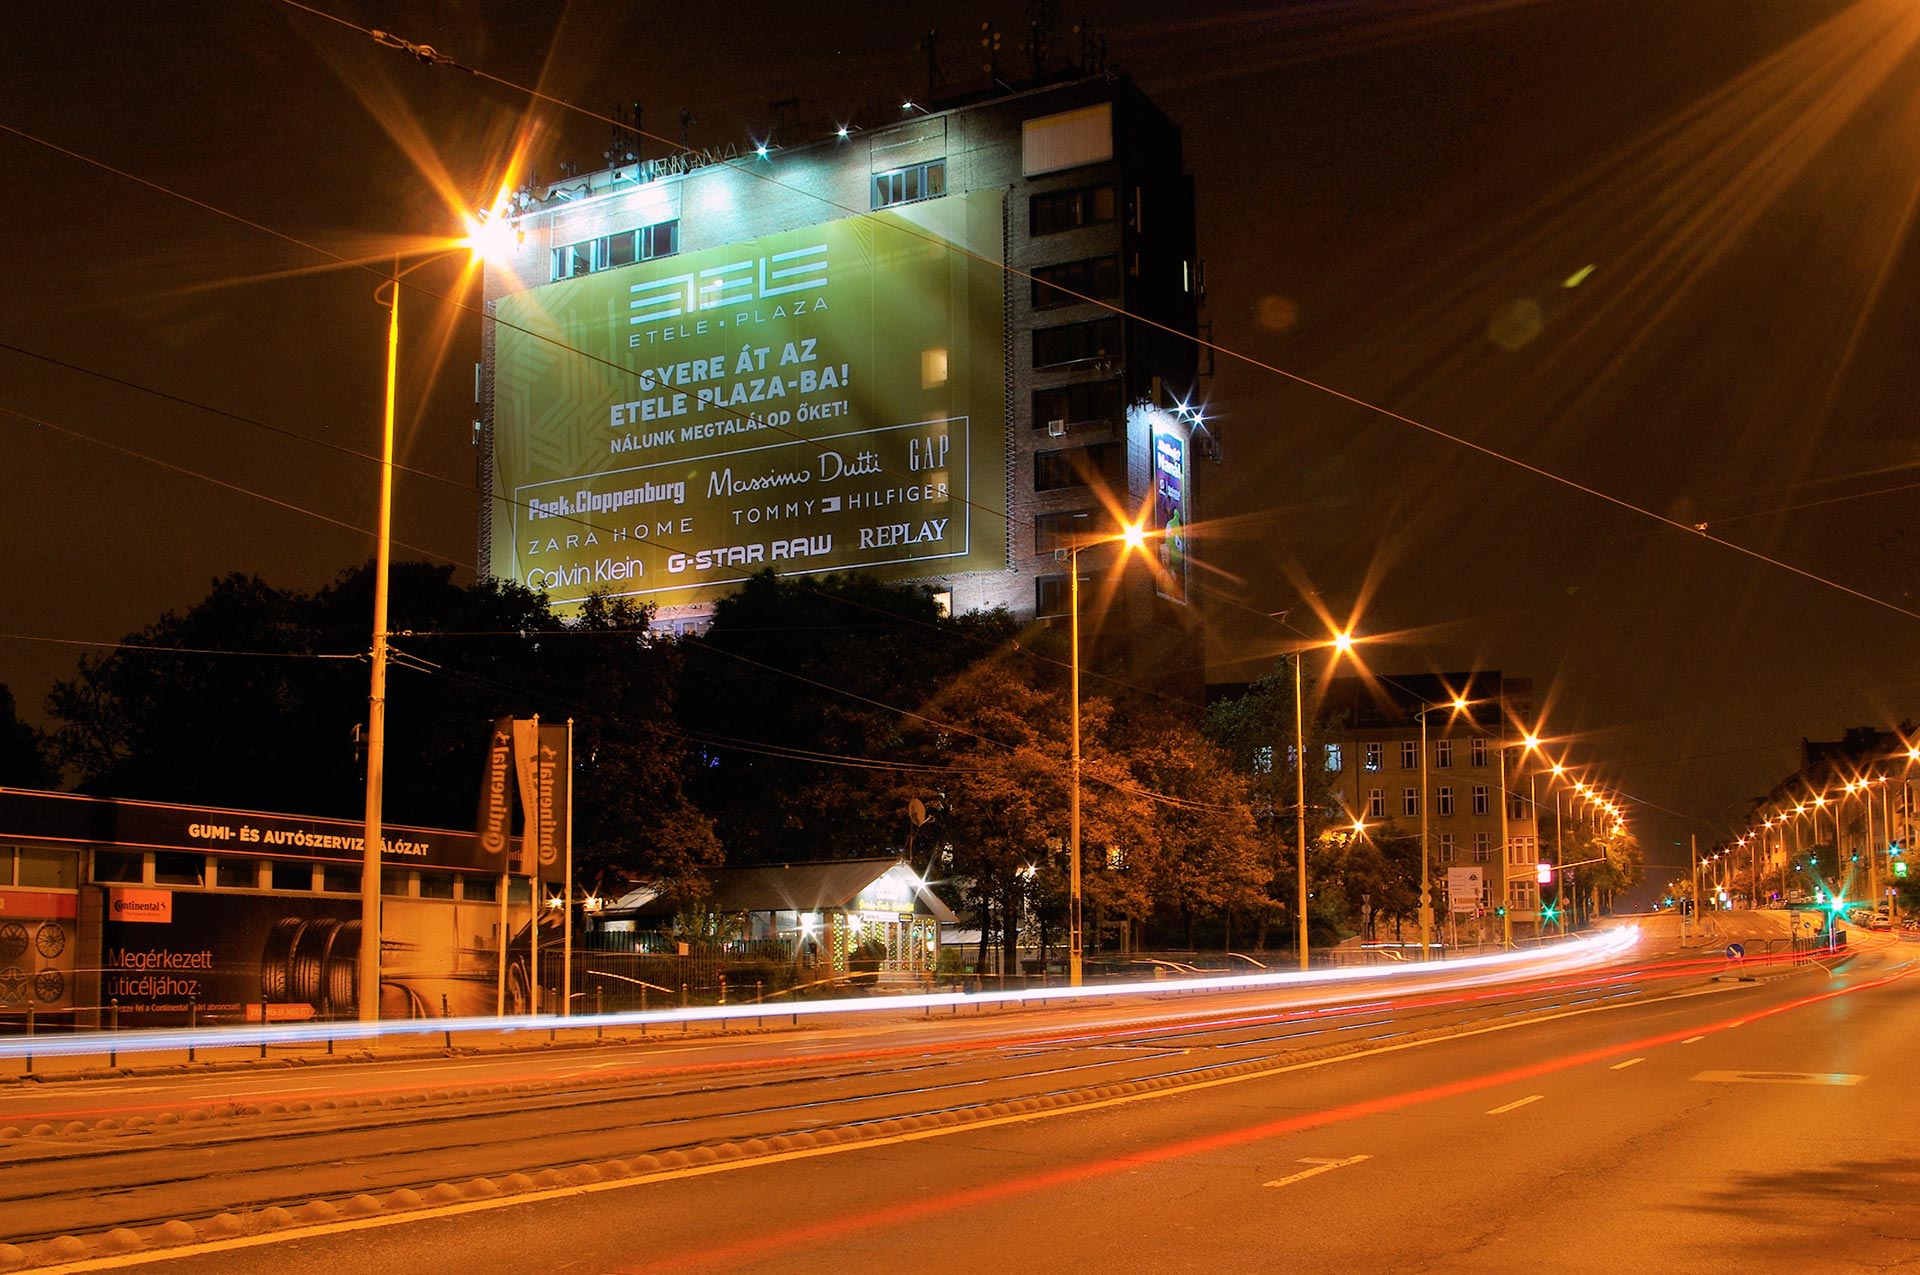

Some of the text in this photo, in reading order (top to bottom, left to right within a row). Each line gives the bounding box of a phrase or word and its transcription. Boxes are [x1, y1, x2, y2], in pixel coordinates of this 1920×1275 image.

[629, 297, 828, 348] ETELE PLAZA
[639, 338, 817, 391] GYERE ÁT AZ
[610, 364, 849, 427] ETELE PLAZA-BA!
[610, 400, 849, 454] NÁLUNK MEGTALÁLOD ŐKET!
[909, 434, 949, 472] GAP
[707, 451, 882, 498] Massimo Dutti
[732, 483, 949, 526] TOMMY HILFIGER
[528, 517, 693, 555] ZARA HOME
[859, 518, 949, 549] REPLAY
[527, 555, 643, 591] Calvin Klein
[667, 534, 832, 574] G-STAR RAW
[188, 823, 429, 856] GUMI- ÉS AUTÓSZERVIZ ÁLÓZAT
[114, 899, 160, 912] Continental
[109, 948, 213, 971] Megérkezett
